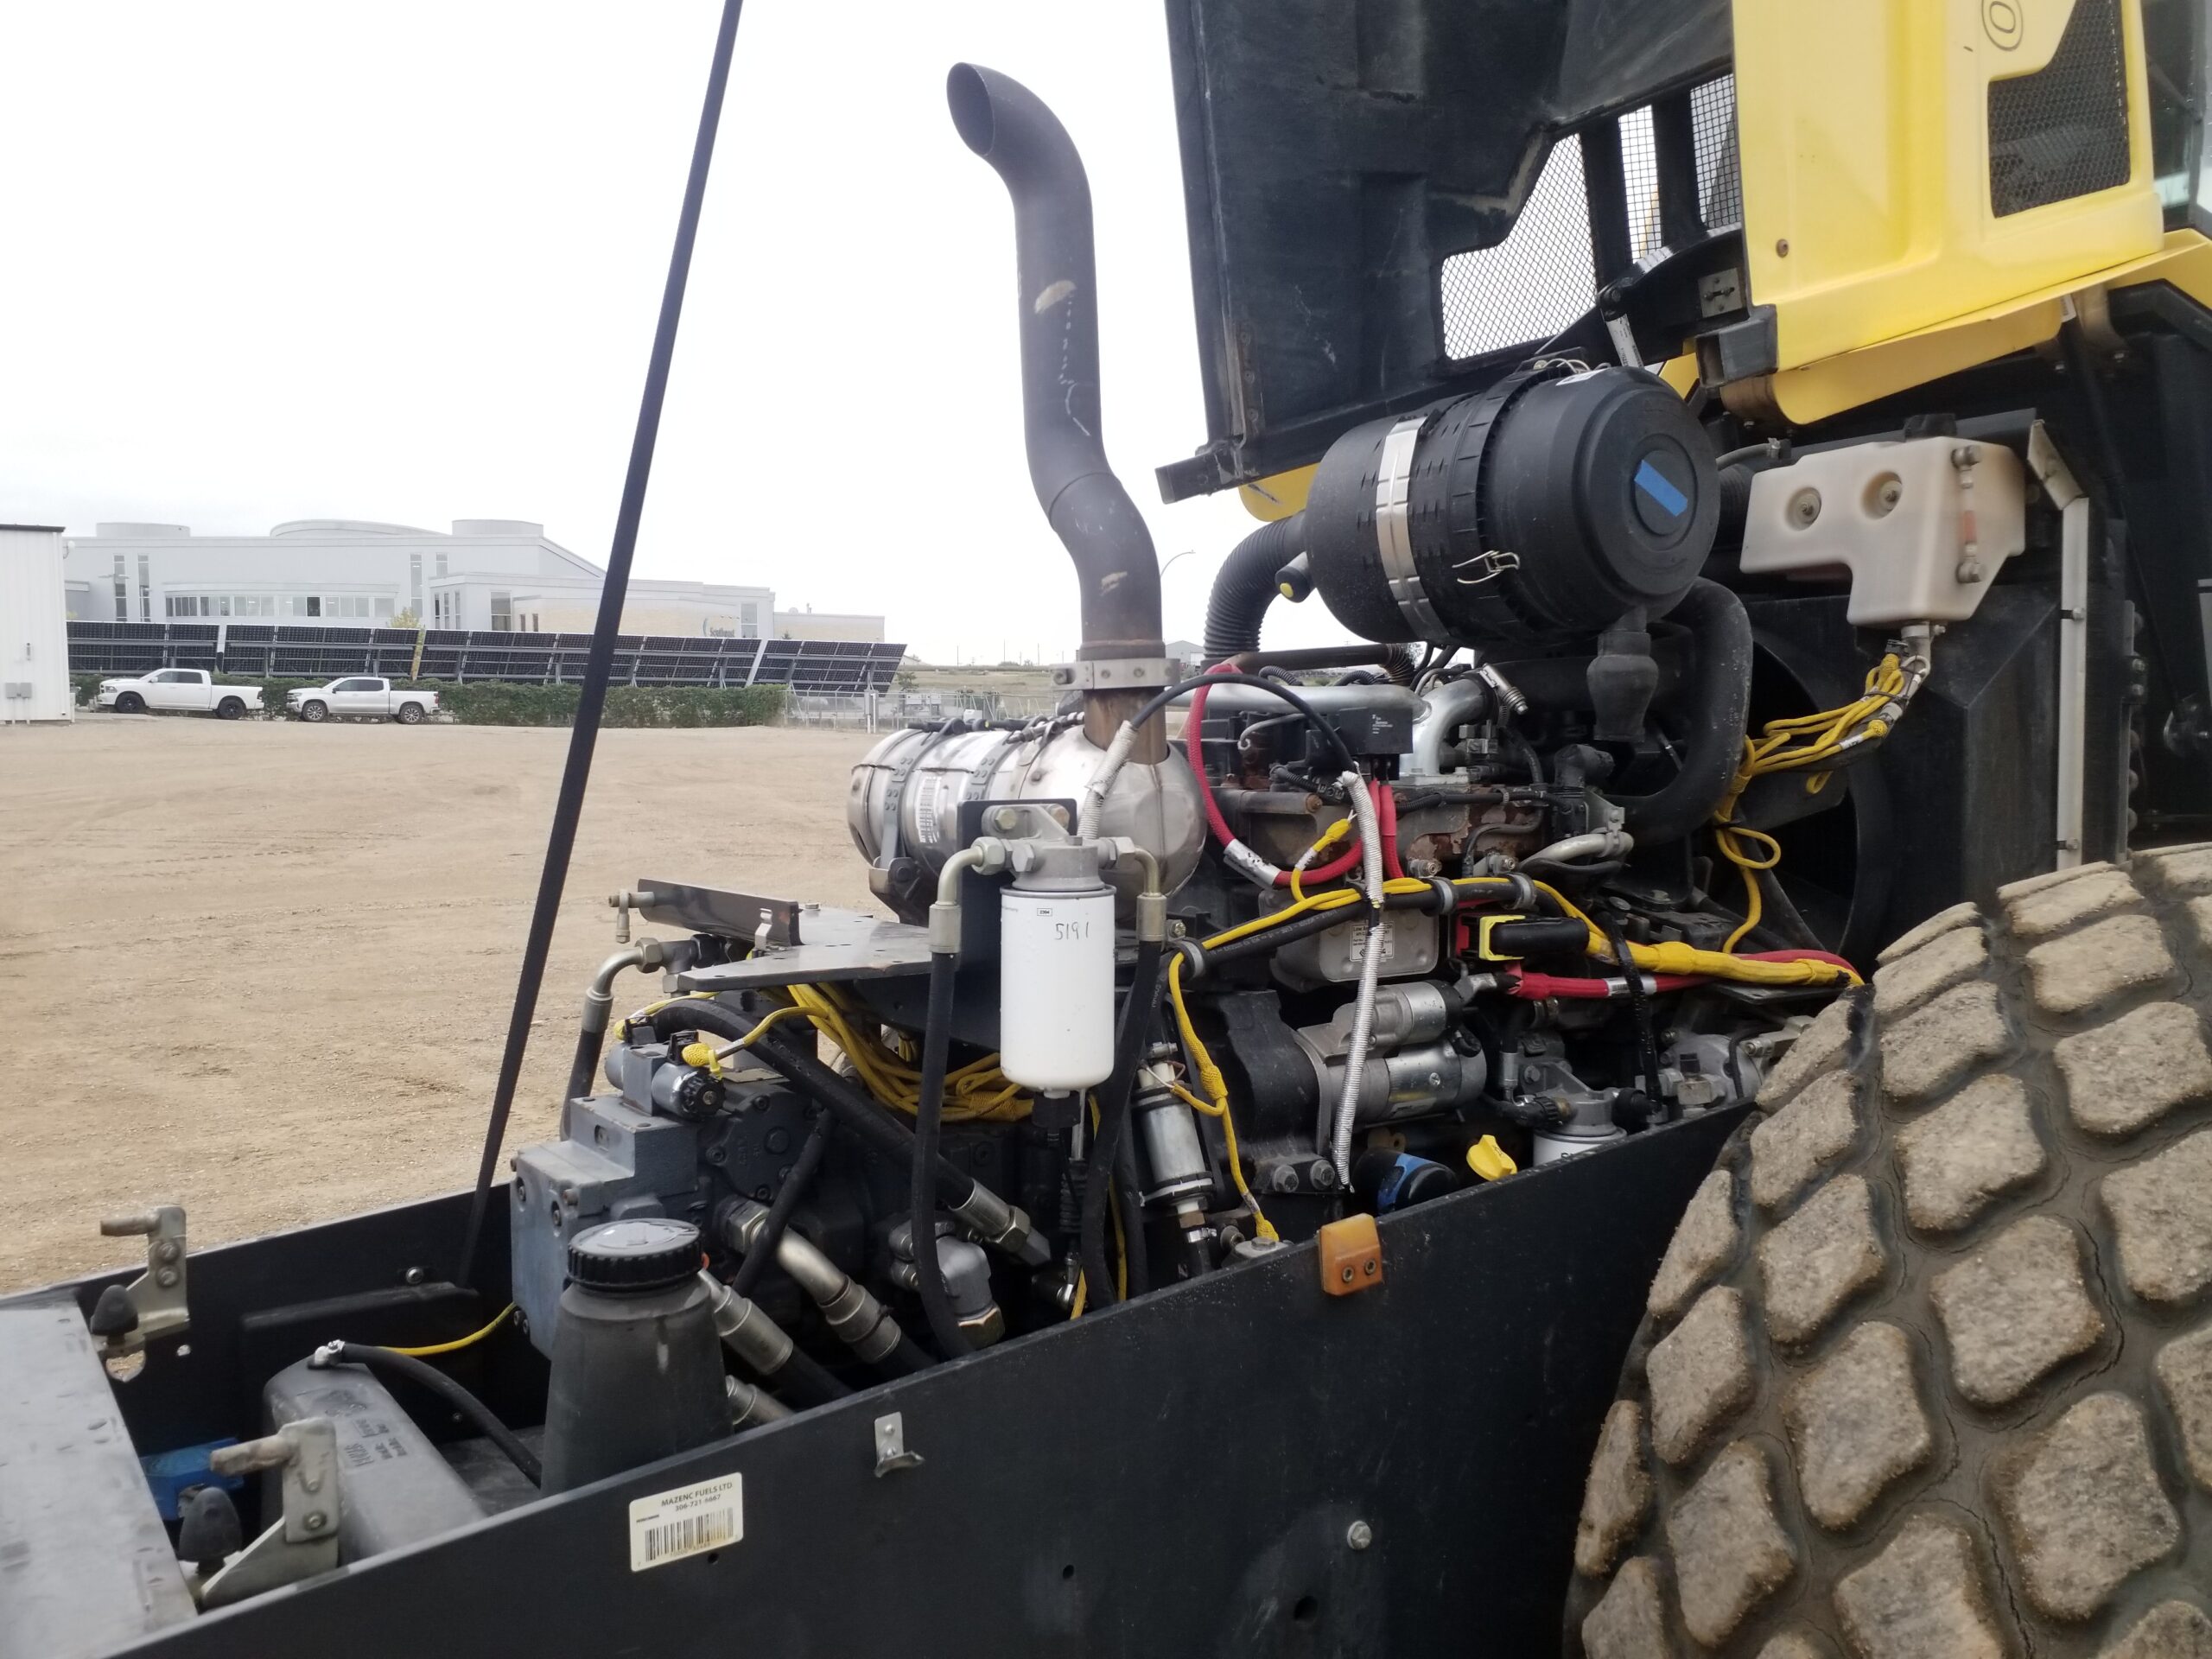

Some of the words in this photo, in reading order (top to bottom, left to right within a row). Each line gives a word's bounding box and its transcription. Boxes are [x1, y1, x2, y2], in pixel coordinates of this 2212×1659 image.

[1055, 921, 1089, 940] 5191
[661, 1492, 693, 1507] MAZENC
[695, 1486, 718, 1497] FUELS
[719, 1482, 733, 1491] LTD
